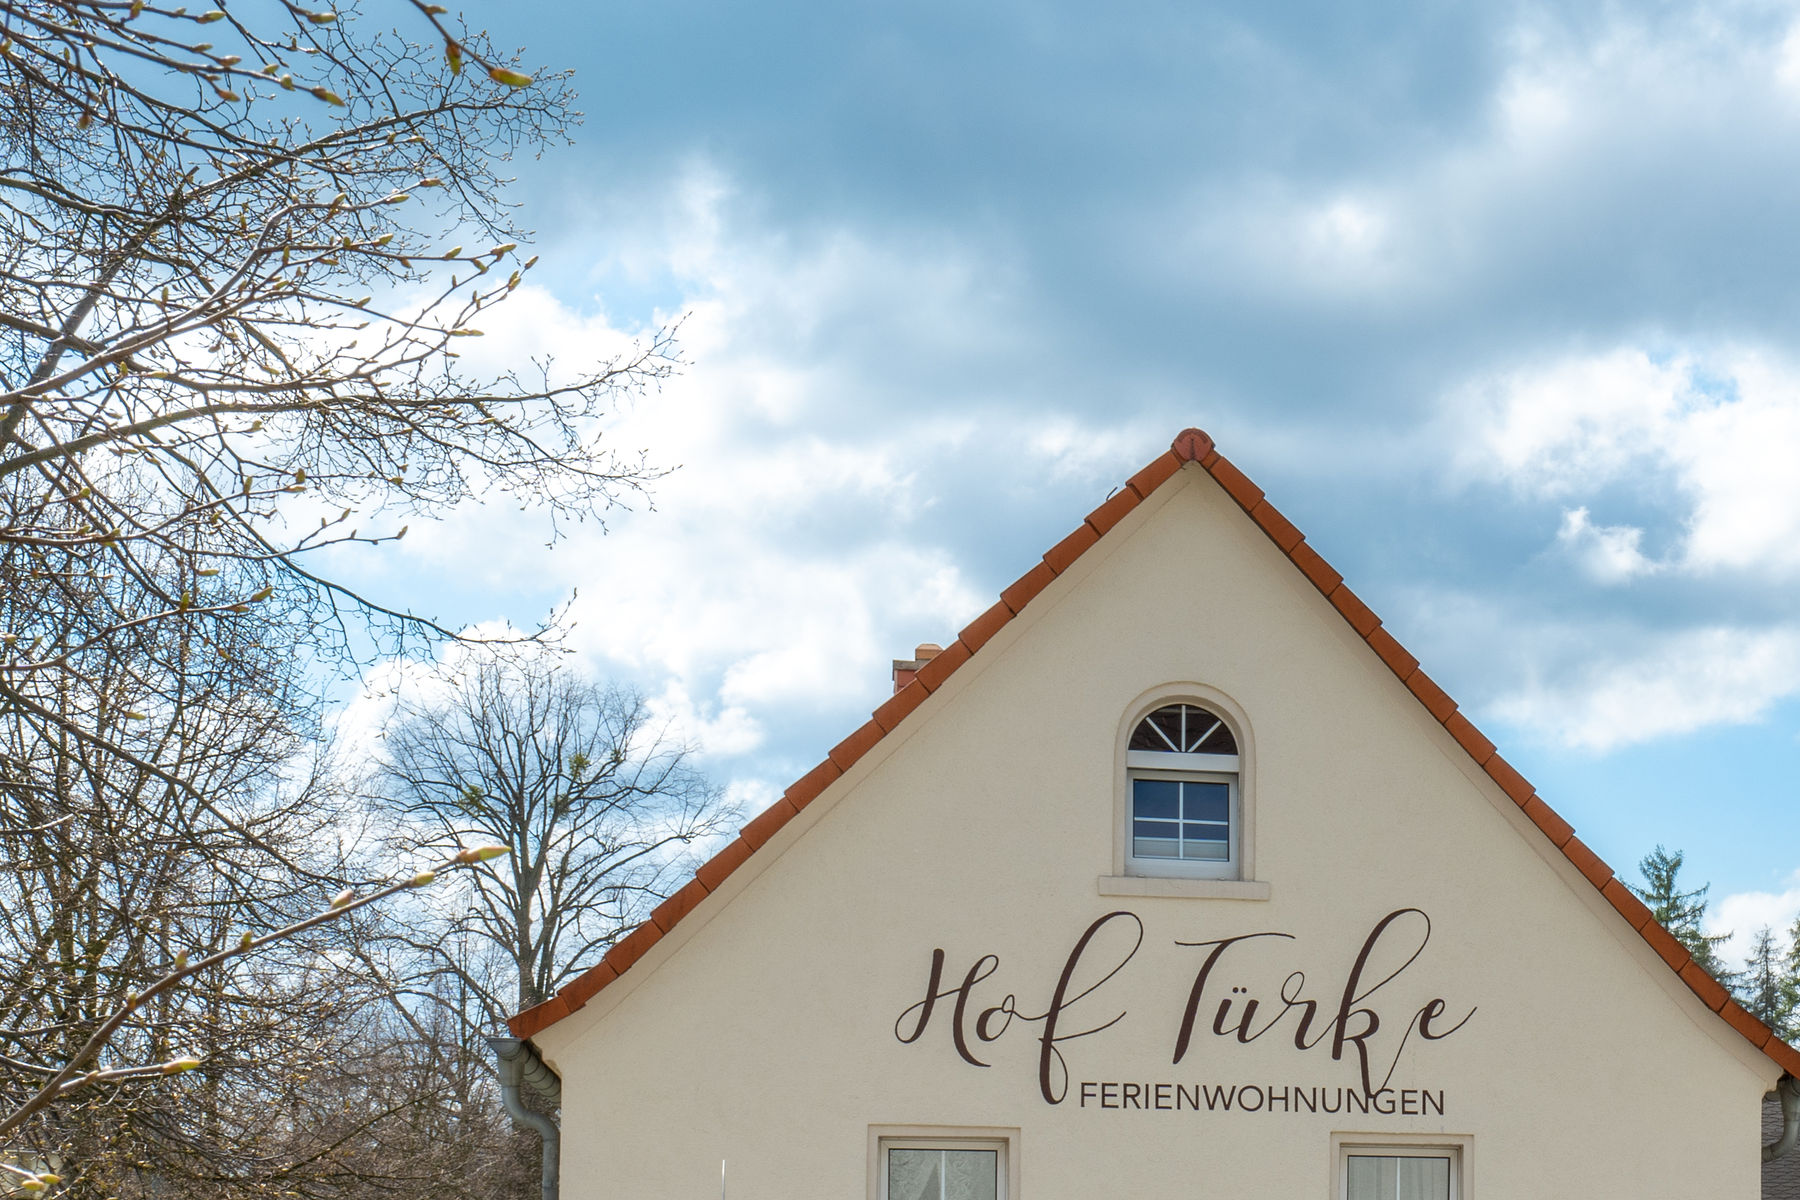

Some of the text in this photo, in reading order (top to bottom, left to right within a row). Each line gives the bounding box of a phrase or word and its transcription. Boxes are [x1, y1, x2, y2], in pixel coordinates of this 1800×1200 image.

[895, 908, 1477, 1105] Hof Türke
[1080, 1082, 1445, 1116] FERIENWOHNUNGEN
